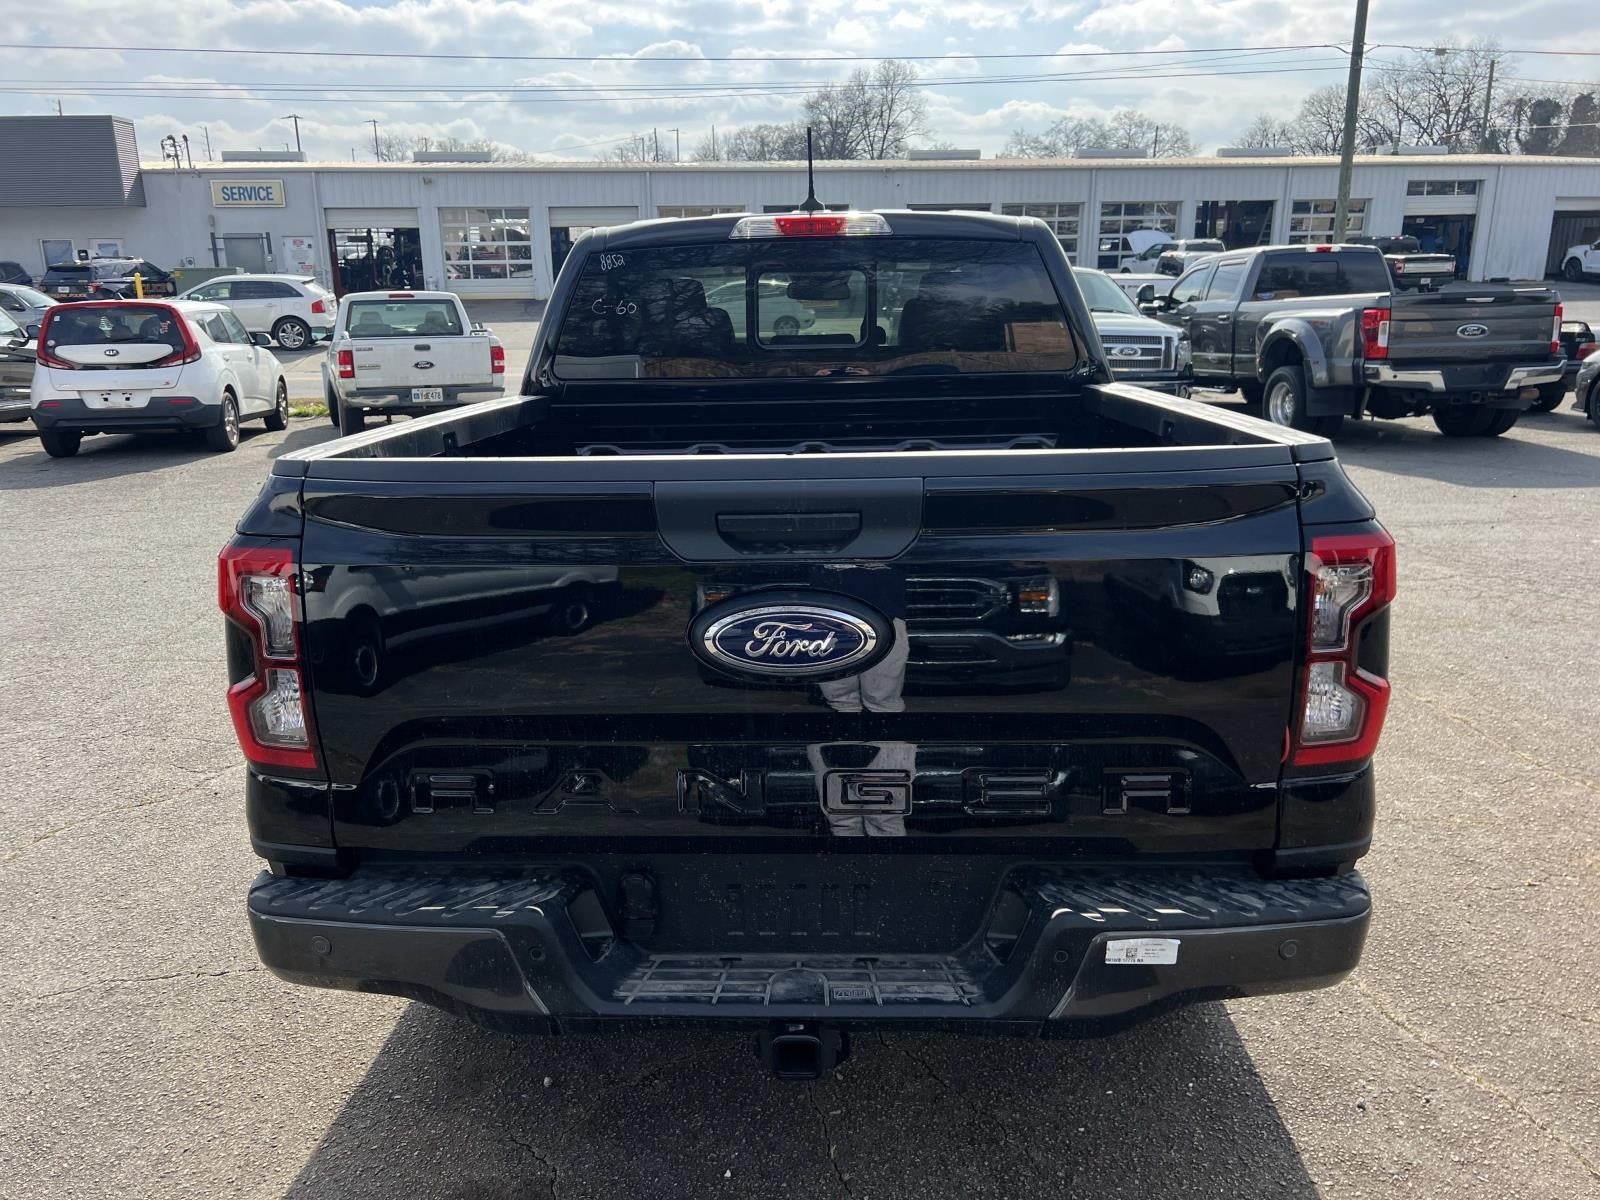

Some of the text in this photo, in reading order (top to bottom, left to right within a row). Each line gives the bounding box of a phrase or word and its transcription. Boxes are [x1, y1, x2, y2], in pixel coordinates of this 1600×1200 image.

[221, 186, 274, 201] SERVICE
[600, 254, 625, 271] 8852
[744, 621, 839, 658] Ford
[409, 768, 1192, 815] RANGER
